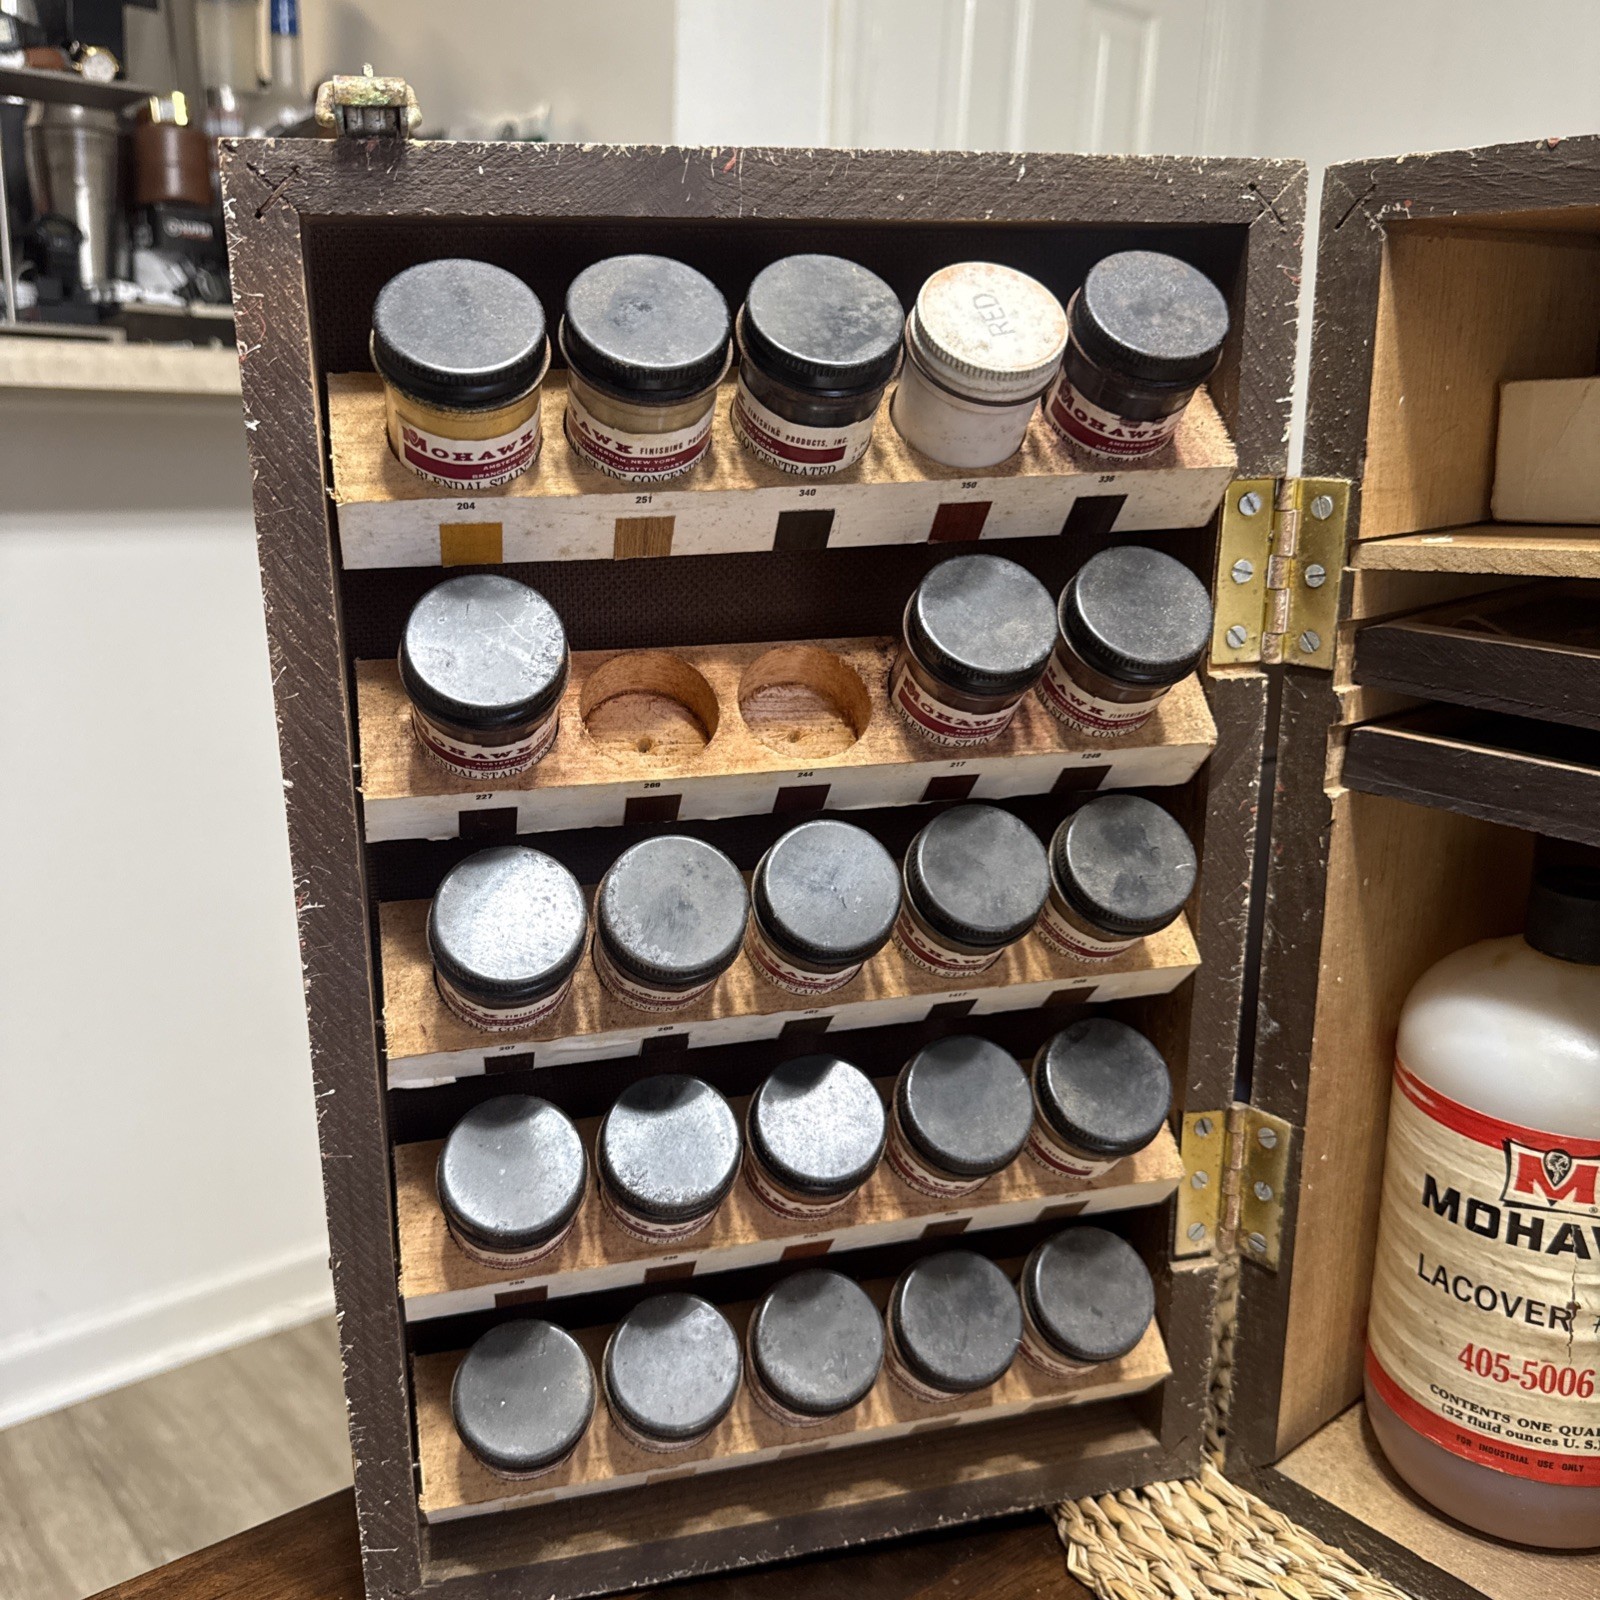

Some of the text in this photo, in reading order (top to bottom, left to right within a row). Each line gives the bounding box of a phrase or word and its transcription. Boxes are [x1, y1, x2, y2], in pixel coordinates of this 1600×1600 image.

[973, 293, 1016, 337] RED
[747, 406, 781, 437] FINISHING
[1058, 378, 1166, 439] MOHAWK
[401, 426, 534, 462] MOHAWK
[640, 442, 683, 456] FINISHING
[654, 456, 676, 464] YORK
[739, 430, 836, 476] CONCENTRATED
[612, 462, 640, 471] COAST
[657, 460, 684, 471] COAST
[635, 496, 653, 504] 251
[798, 488, 817, 497] 340
[961, 481, 977, 489] 350
[457, 502, 476, 510] 204
[903, 676, 1007, 727] MOHAWK
[900, 708, 951, 746] BLENDAL
[475, 793, 493, 801] 227
[1422, 1173, 1600, 1260] MOHA
[1417, 1252, 1570, 1332] LACOVER
[1458, 1343, 1595, 1398] 405-5006
[1430, 1384, 1511, 1423] CONTENTS
[1517, 1418, 1552, 1433] ONE
[1441, 1403, 1463, 1420] (32
[1467, 1415, 1501, 1434] fluid
[1506, 1429, 1559, 1446] ounces
[1584, 1439, 1600, 1451] S.
[1456, 1434, 1585, 1472] FOR INDUSTRIAL USE ONLY
